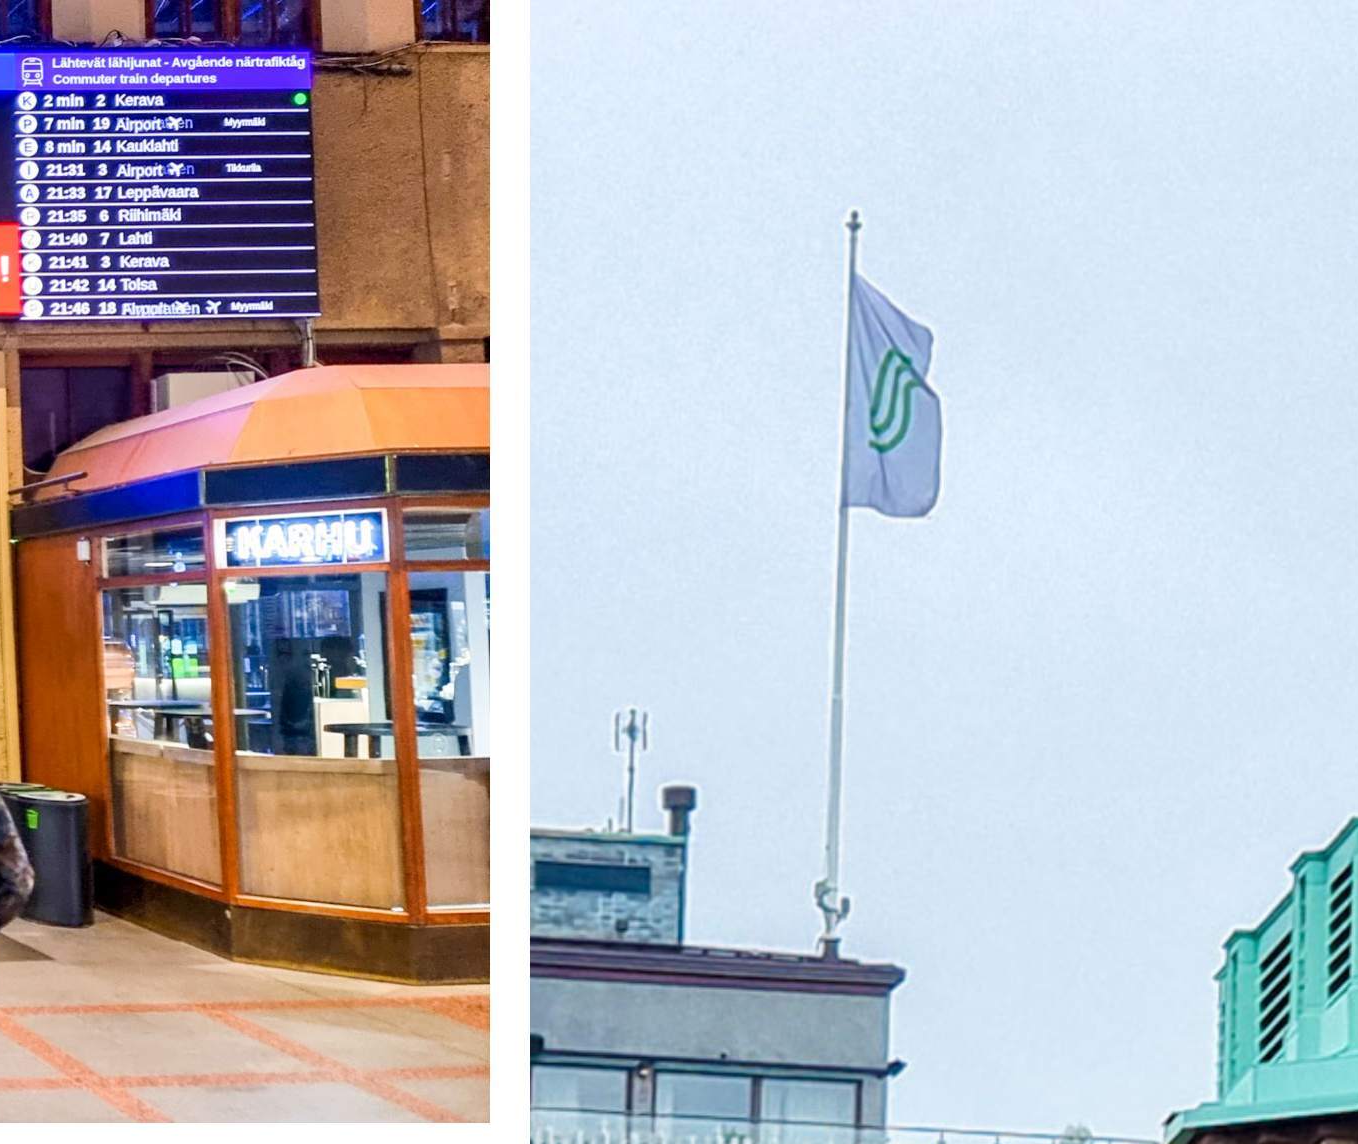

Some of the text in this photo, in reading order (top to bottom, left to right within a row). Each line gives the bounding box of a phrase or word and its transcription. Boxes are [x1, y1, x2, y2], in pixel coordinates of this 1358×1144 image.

[52, 54, 306, 72] Lähtevät lähijunat Avgående närtrafiktåg
[53, 72, 217, 87] Commuter train departures
[44, 94, 164, 107] 2 min 2 Kerava
[45, 117, 109, 130] 7 min 19
[45, 140, 179, 153] 8 min 14 Kauklahti
[46, 164, 107, 176] 21:31 3
[47, 185, 199, 201] 21:33 17 Leppävaara
[47, 208, 181, 222] 21:35 6 Riihimäki
[48, 232, 153, 245] 21:40 7 Lahti
[49, 255, 170, 268] 21:41 3 Kerava
[49, 279, 116, 291] 21:42 14
[99, 302, 116, 314] 18
[237, 519, 372, 559] KARHU
